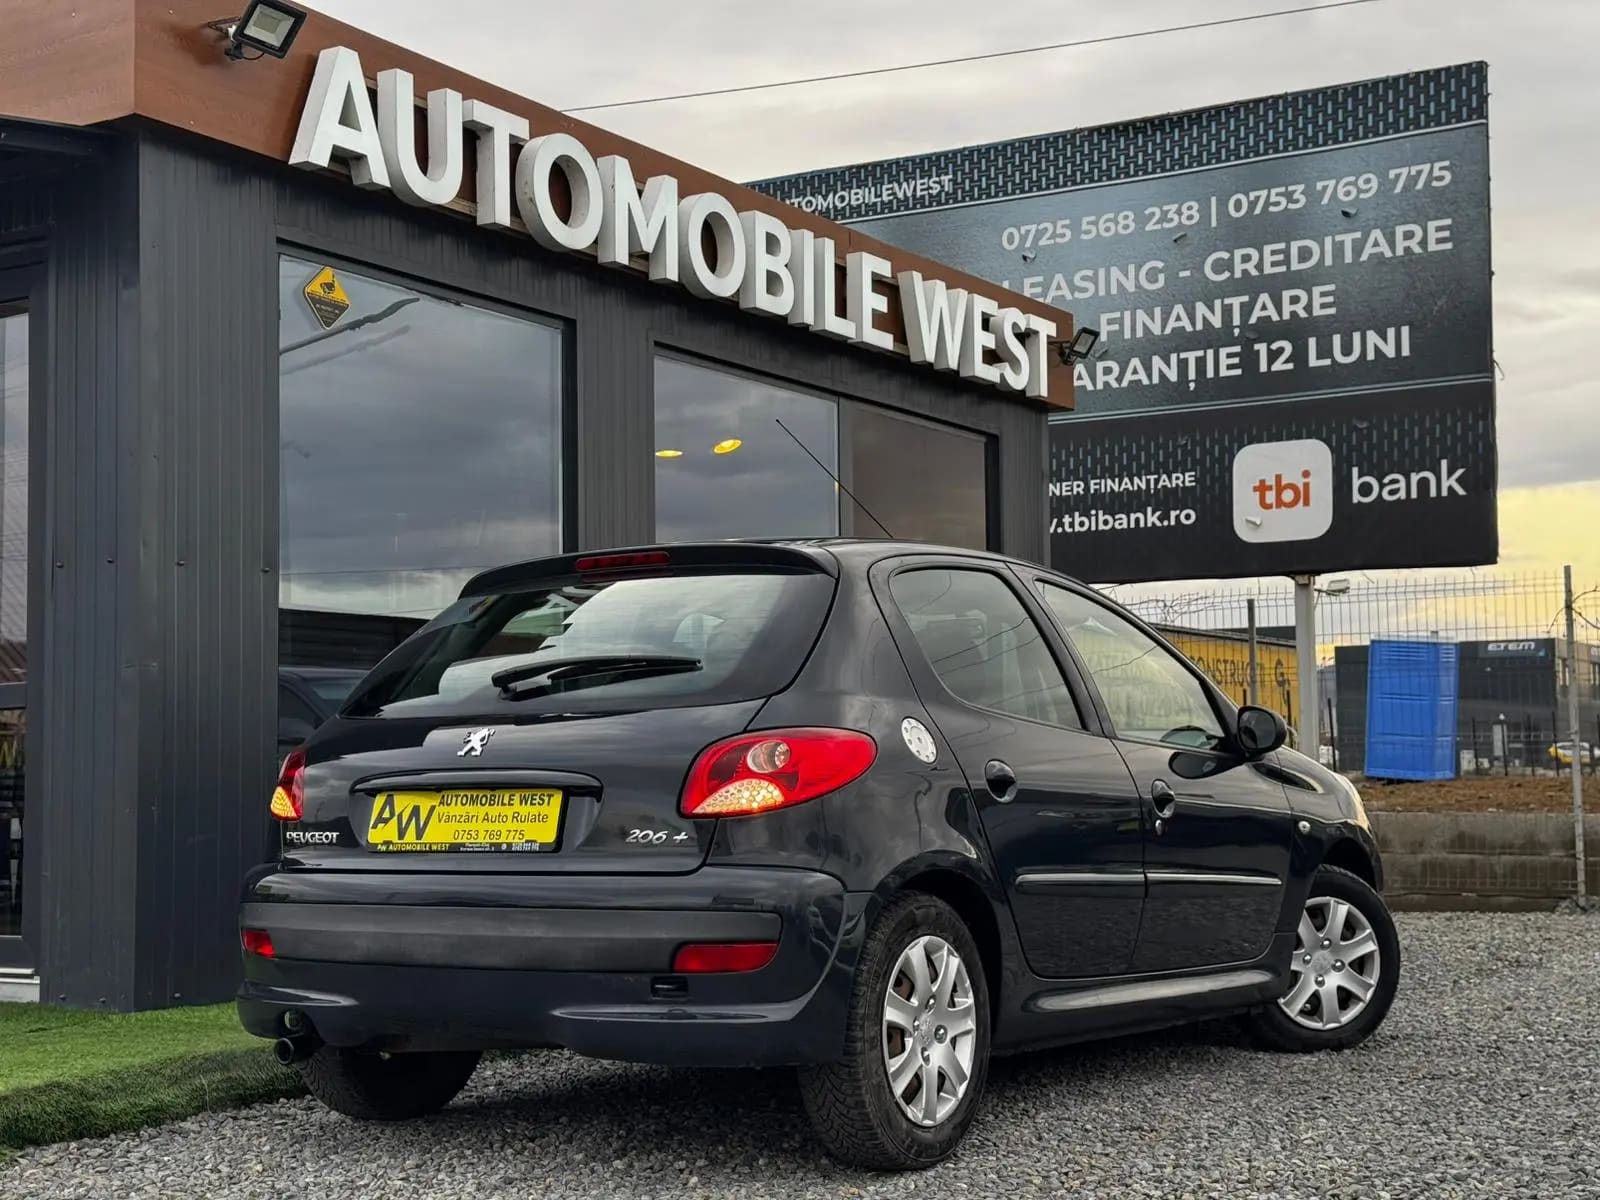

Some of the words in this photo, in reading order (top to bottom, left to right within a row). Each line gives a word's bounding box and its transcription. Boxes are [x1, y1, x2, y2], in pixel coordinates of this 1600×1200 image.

[1002, 219, 1071, 250] 0725
[1080, 211, 1135, 240] 568
[1144, 201, 1199, 231] 238
[1228, 184, 1306, 218] 0753
[1316, 173, 1378, 205] 769
[1389, 160, 1451, 193] 775
[289, 46, 894, 350] AUTOMOBILE
[897, 270, 1056, 398] WEST
[1204, 218, 1453, 282] CREDITARE
[1100, 284, 1336, 342] FINANȚARE
[1073, 345, 1242, 391] ARANȚIE
[1254, 340, 1295, 373] 12
[1308, 325, 1410, 367] LUNI
[1090, 471, 1196, 494] FINANȚARE
[1252, 470, 1312, 510] tbi
[1351, 459, 1467, 504] bank
[1050, 506, 1196, 533] .tbibank.ro
[439, 793, 515, 807] AUTOMOBILE
[519, 793, 554, 806] WEST
[481, 811, 508, 824] Auto
[511, 811, 549, 824] Rulate
[286, 831, 340, 844] PEUGEOT
[432, 843, 450, 851] WEST
[453, 830, 479, 841] 0753
[483, 830, 502, 841] 769
[505, 829, 525, 841] 775
[625, 829, 669, 844] 206
